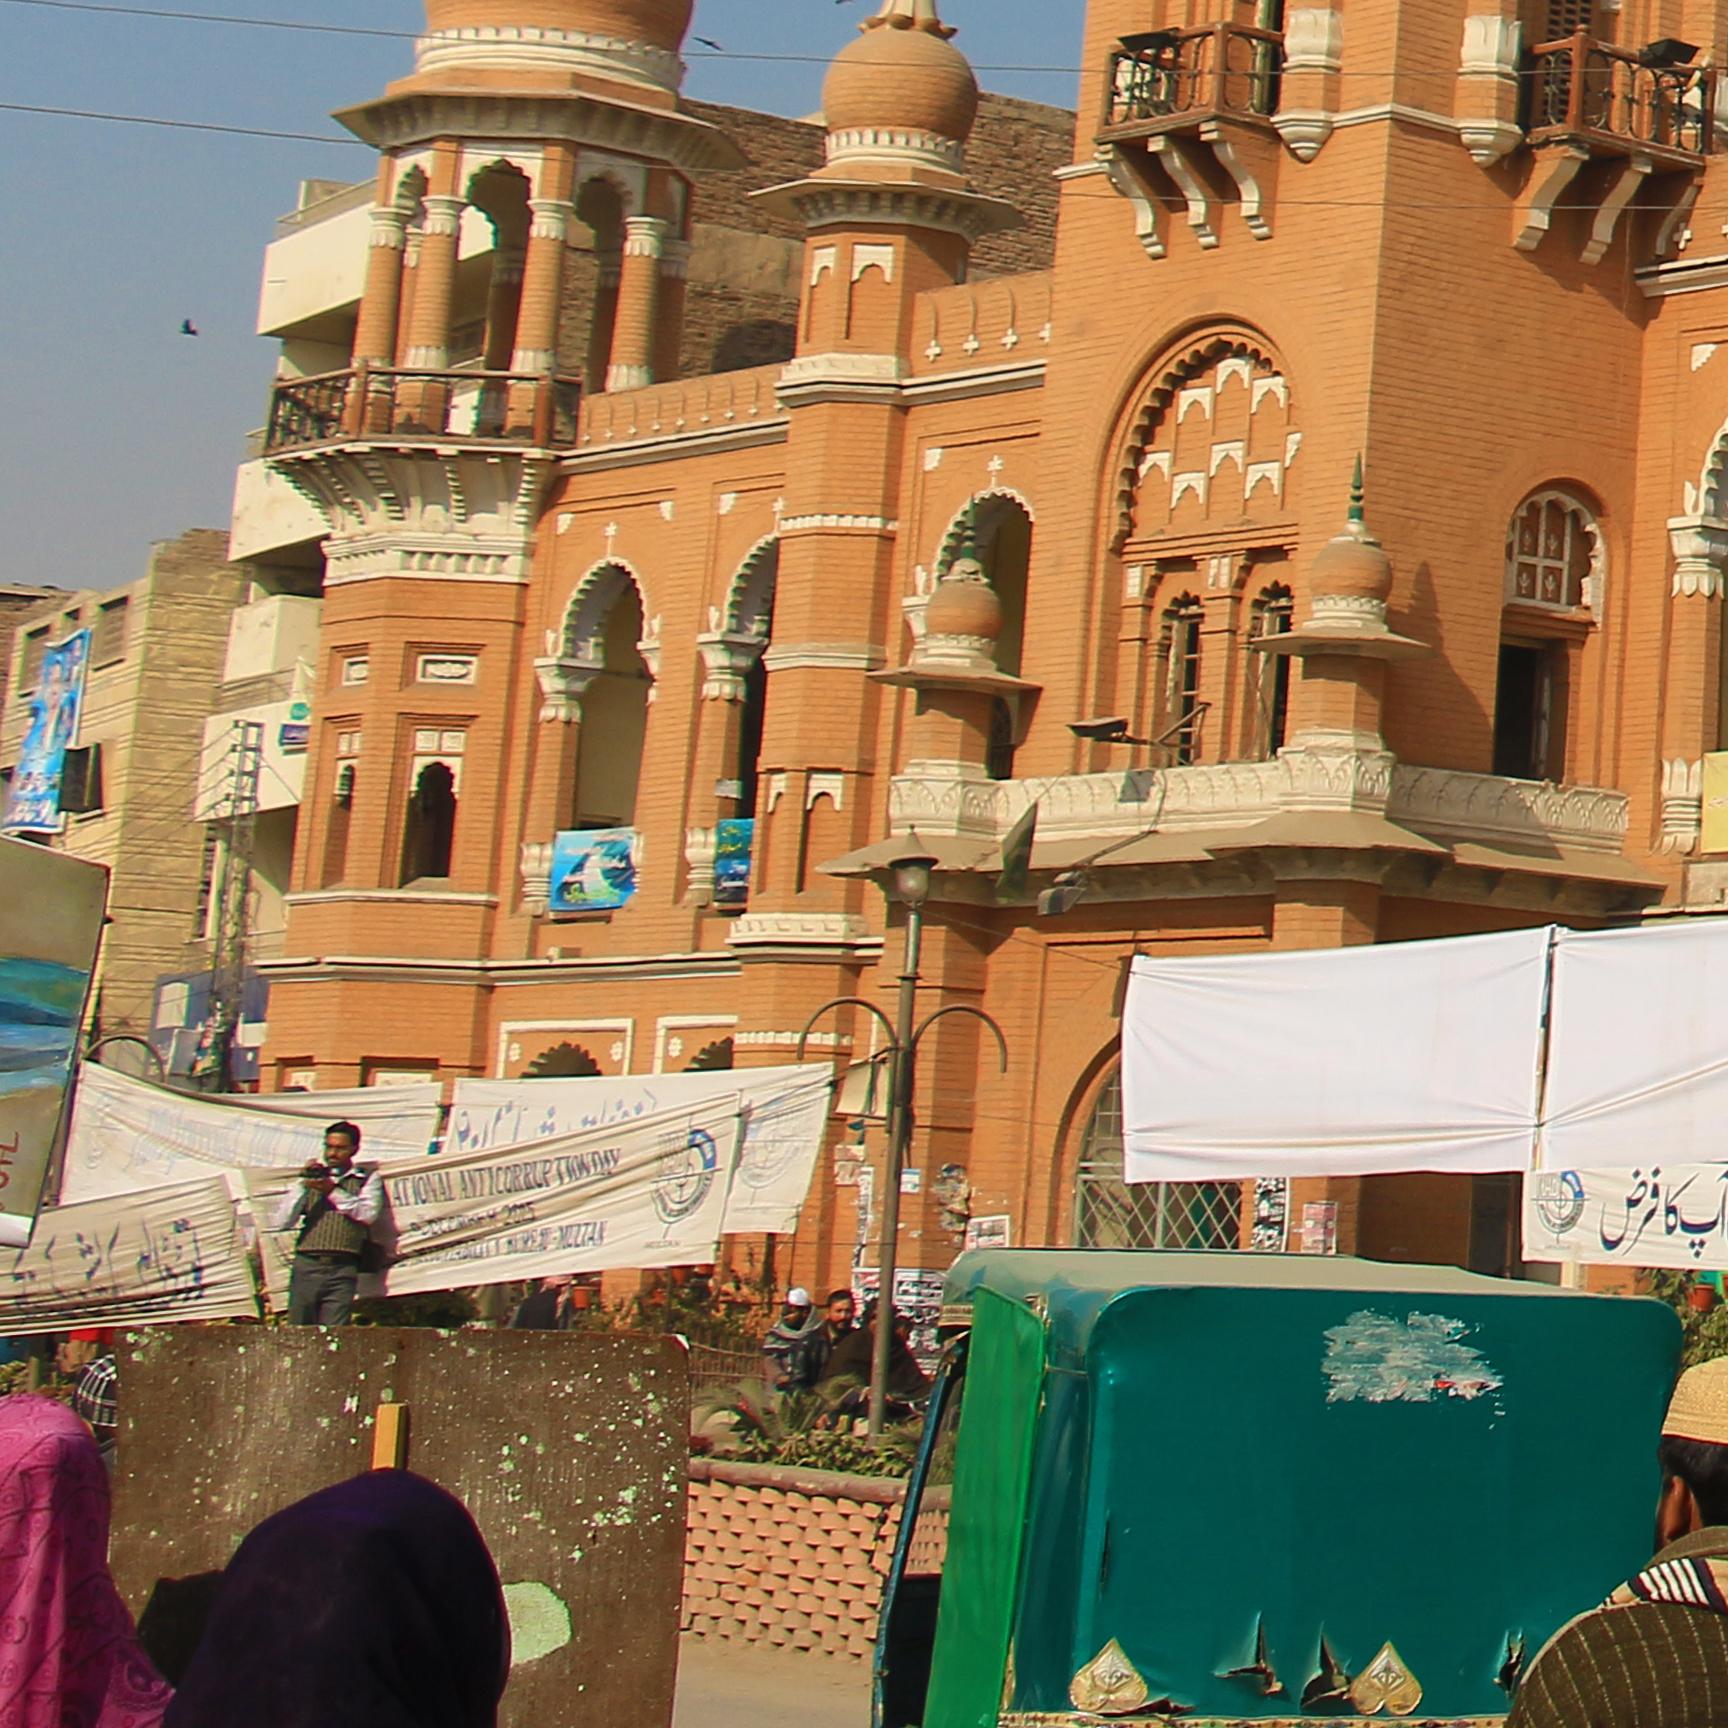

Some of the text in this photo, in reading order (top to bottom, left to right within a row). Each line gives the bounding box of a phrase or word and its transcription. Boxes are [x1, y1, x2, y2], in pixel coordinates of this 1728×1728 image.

[392, 1171, 456, 1208] ATIONAL
[1599, 1165, 1661, 1257] فرض
[1663, 1171, 1701, 1236] کا
